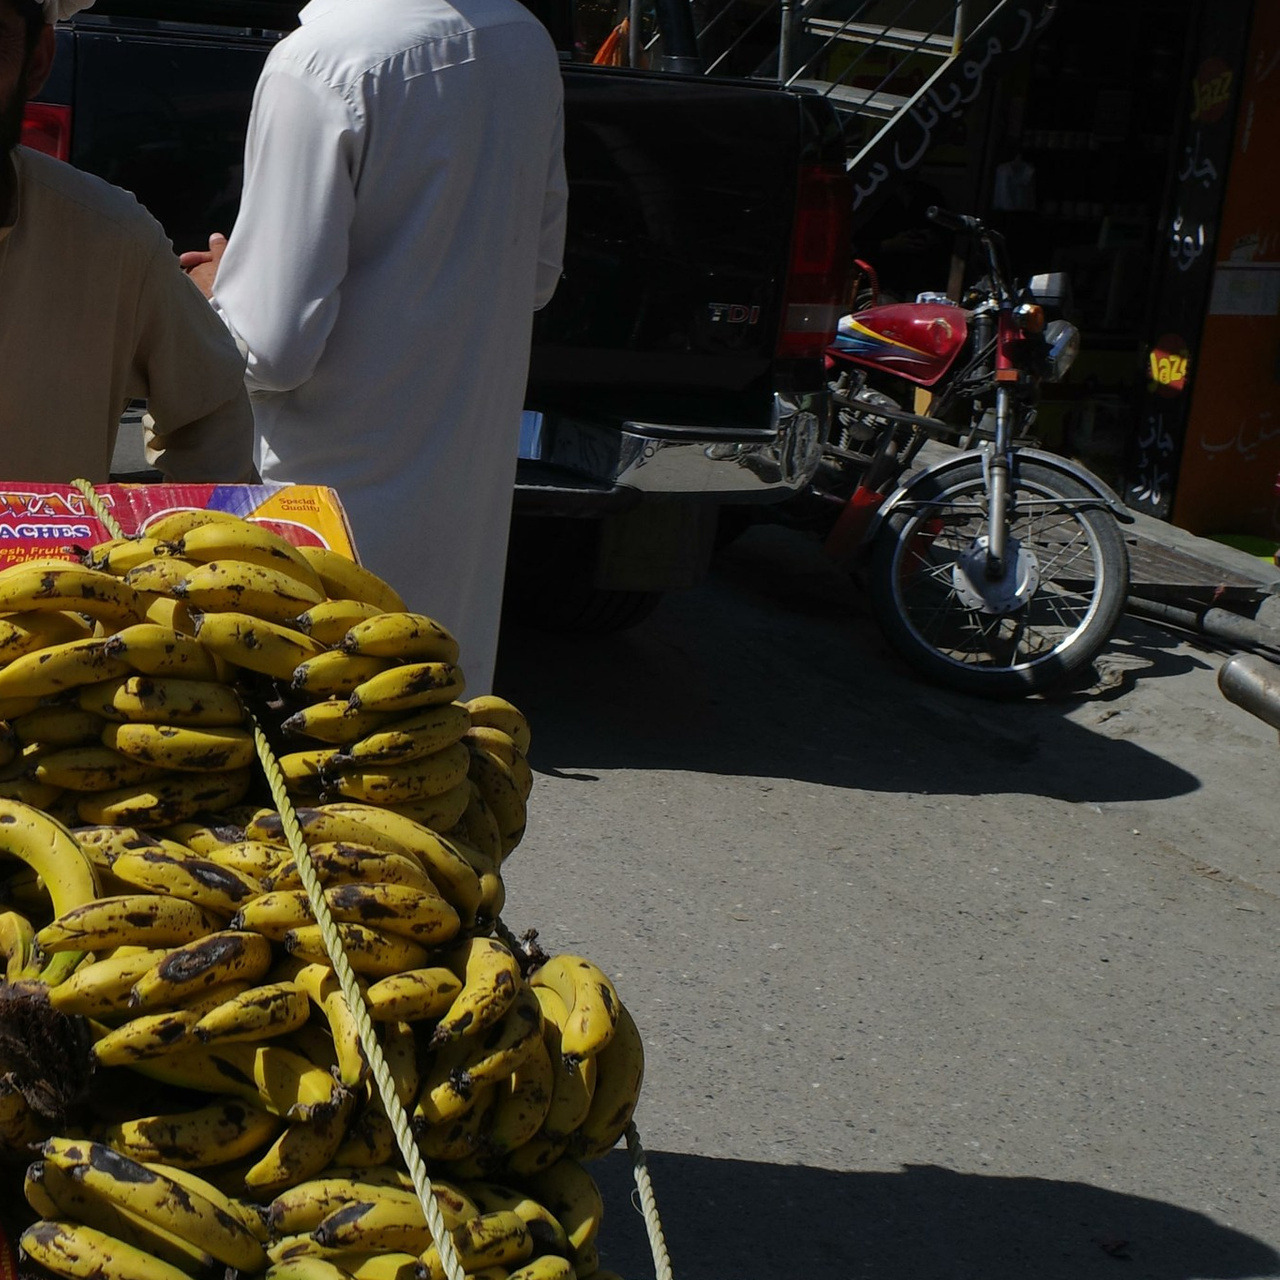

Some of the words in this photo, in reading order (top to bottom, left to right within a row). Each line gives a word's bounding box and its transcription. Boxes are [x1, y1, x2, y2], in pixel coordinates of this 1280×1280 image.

[1189, 71, 1233, 122] Jazz
[707, 302, 761, 325] TDI
[279, 497, 316, 505] Special
[281, 504, 320, 512] Quality
